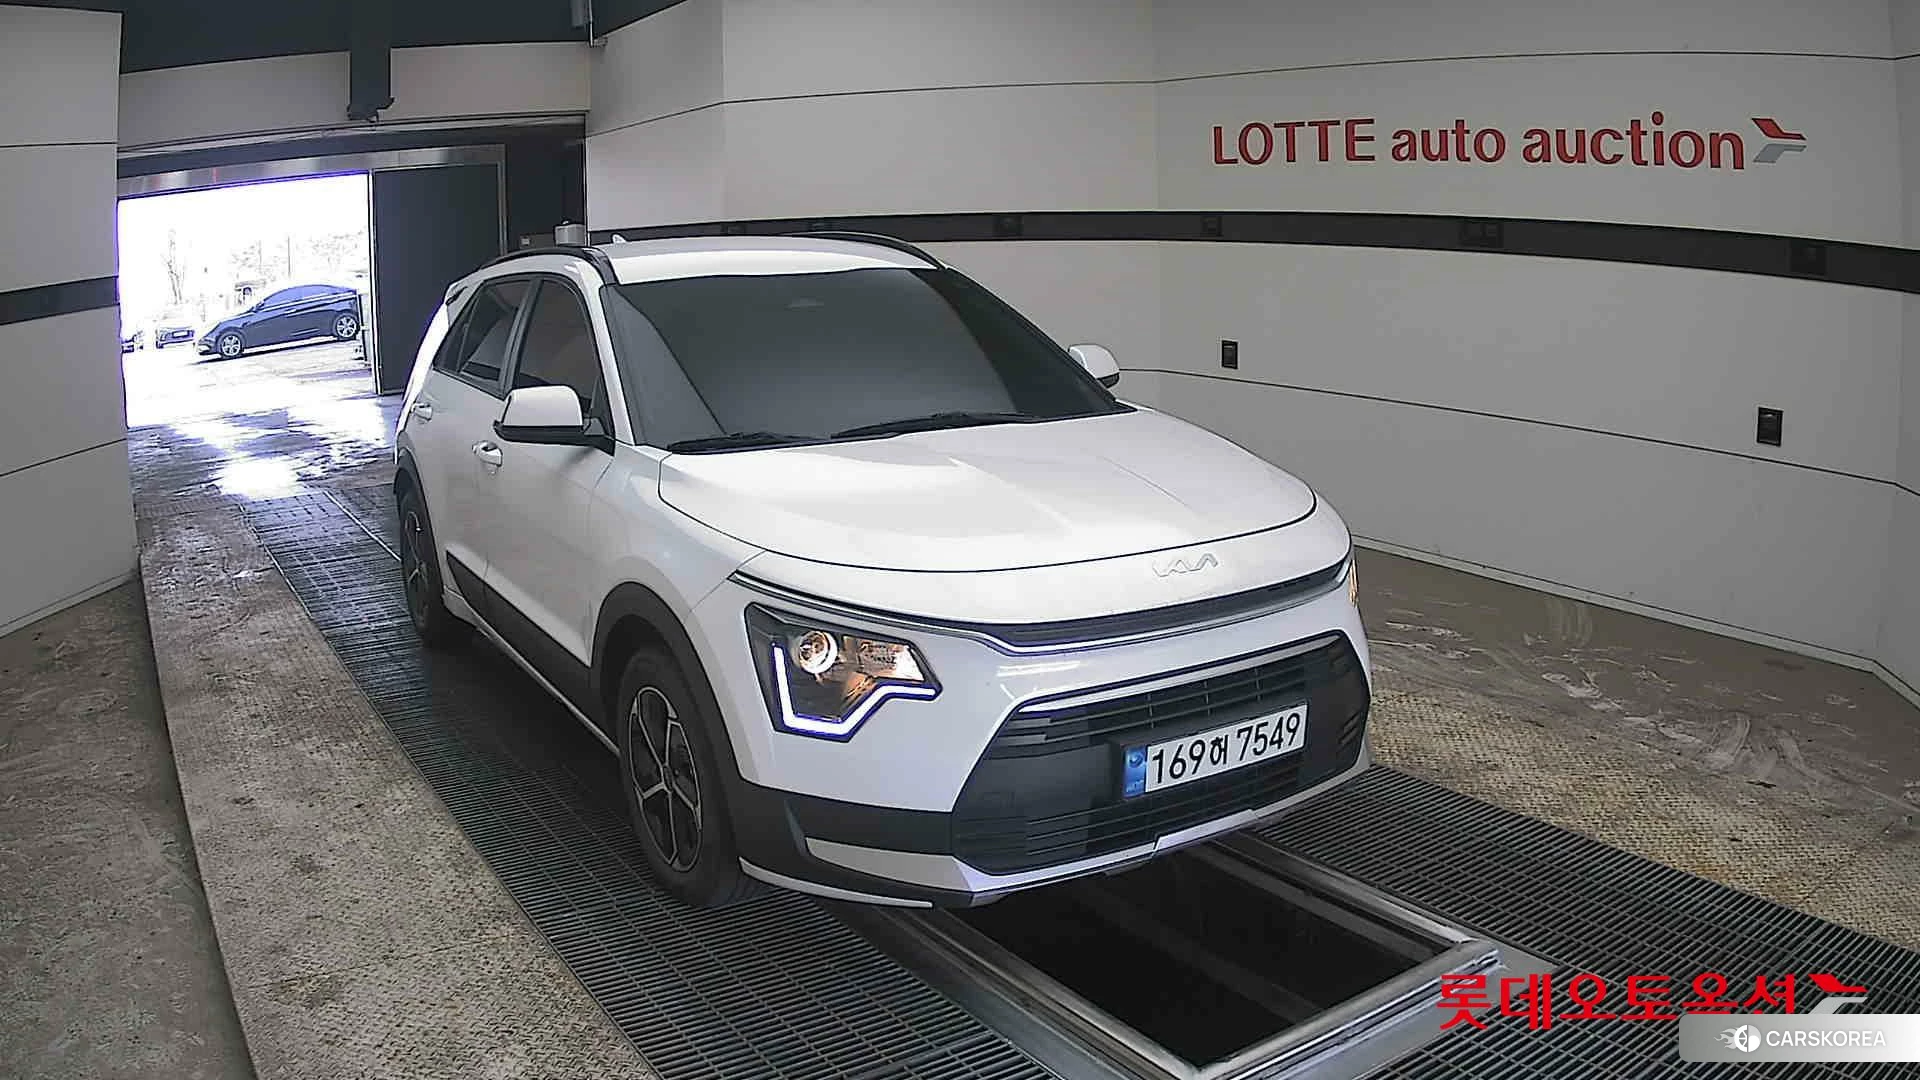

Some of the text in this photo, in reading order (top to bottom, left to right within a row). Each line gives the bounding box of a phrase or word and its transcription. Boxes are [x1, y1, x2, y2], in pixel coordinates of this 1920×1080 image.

[1212, 111, 1745, 170] LOTTE auto auction
[1151, 712, 1301, 785] 169허 7549
